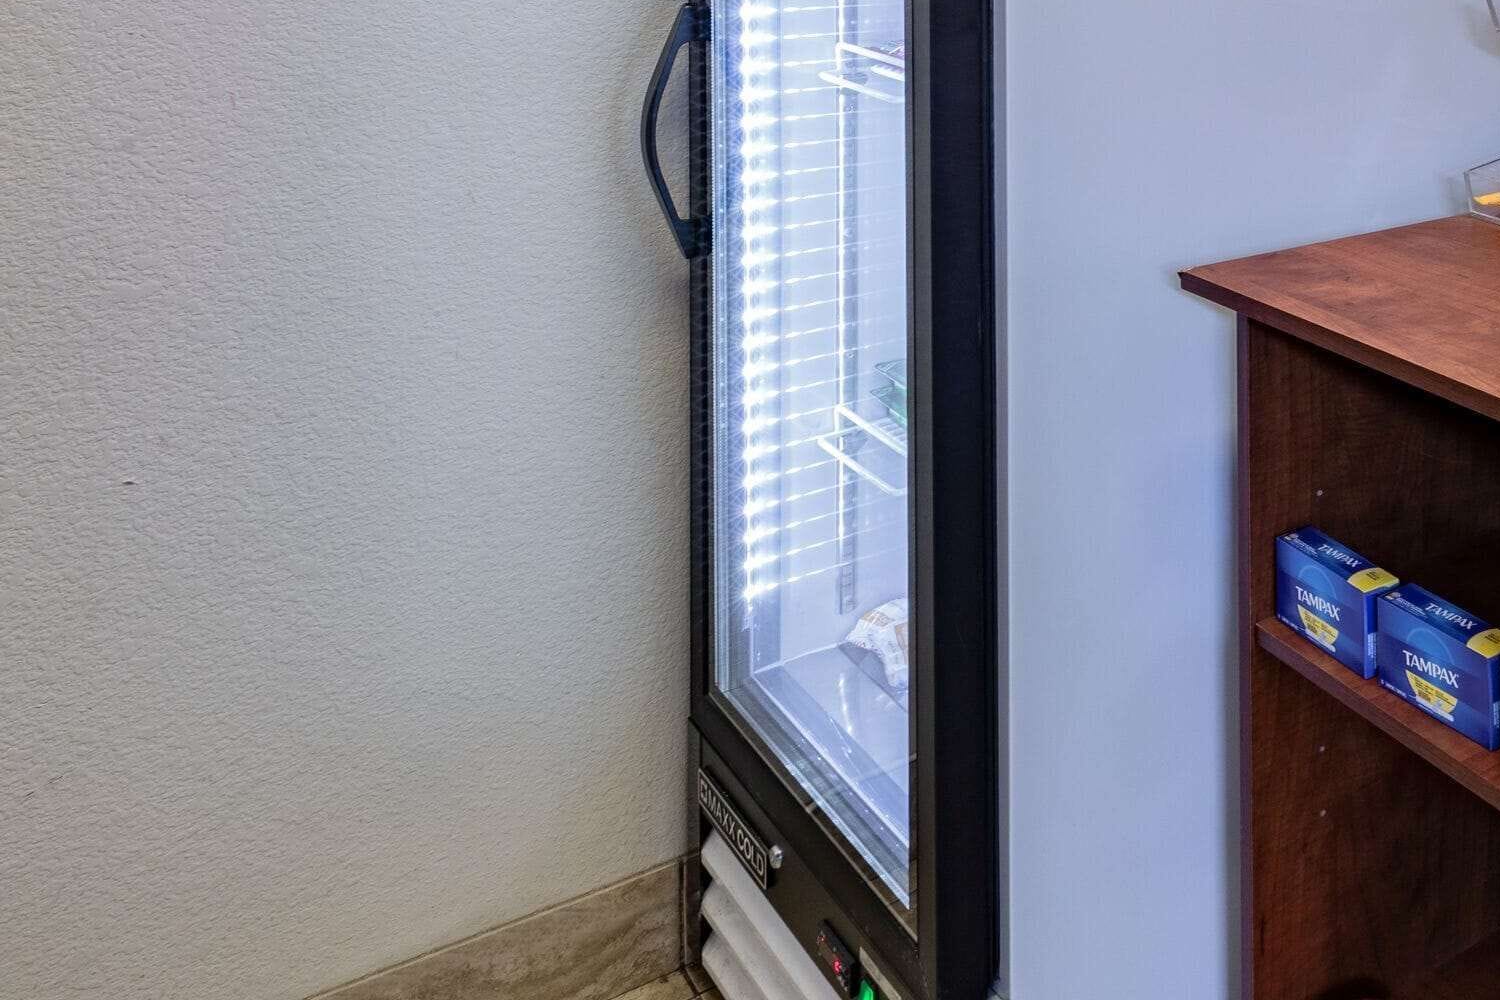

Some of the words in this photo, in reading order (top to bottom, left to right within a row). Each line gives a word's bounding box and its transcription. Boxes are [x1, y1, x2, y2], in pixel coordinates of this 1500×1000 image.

[1317, 543, 1362, 568] TAMPAX
[1296, 585, 1341, 622] TAMPAX
[1425, 602, 1478, 630] TAMPAX
[1402, 650, 1460, 689] TAMPAX
[708, 788, 736, 841] MAXX
[736, 828, 764, 877] COLD
